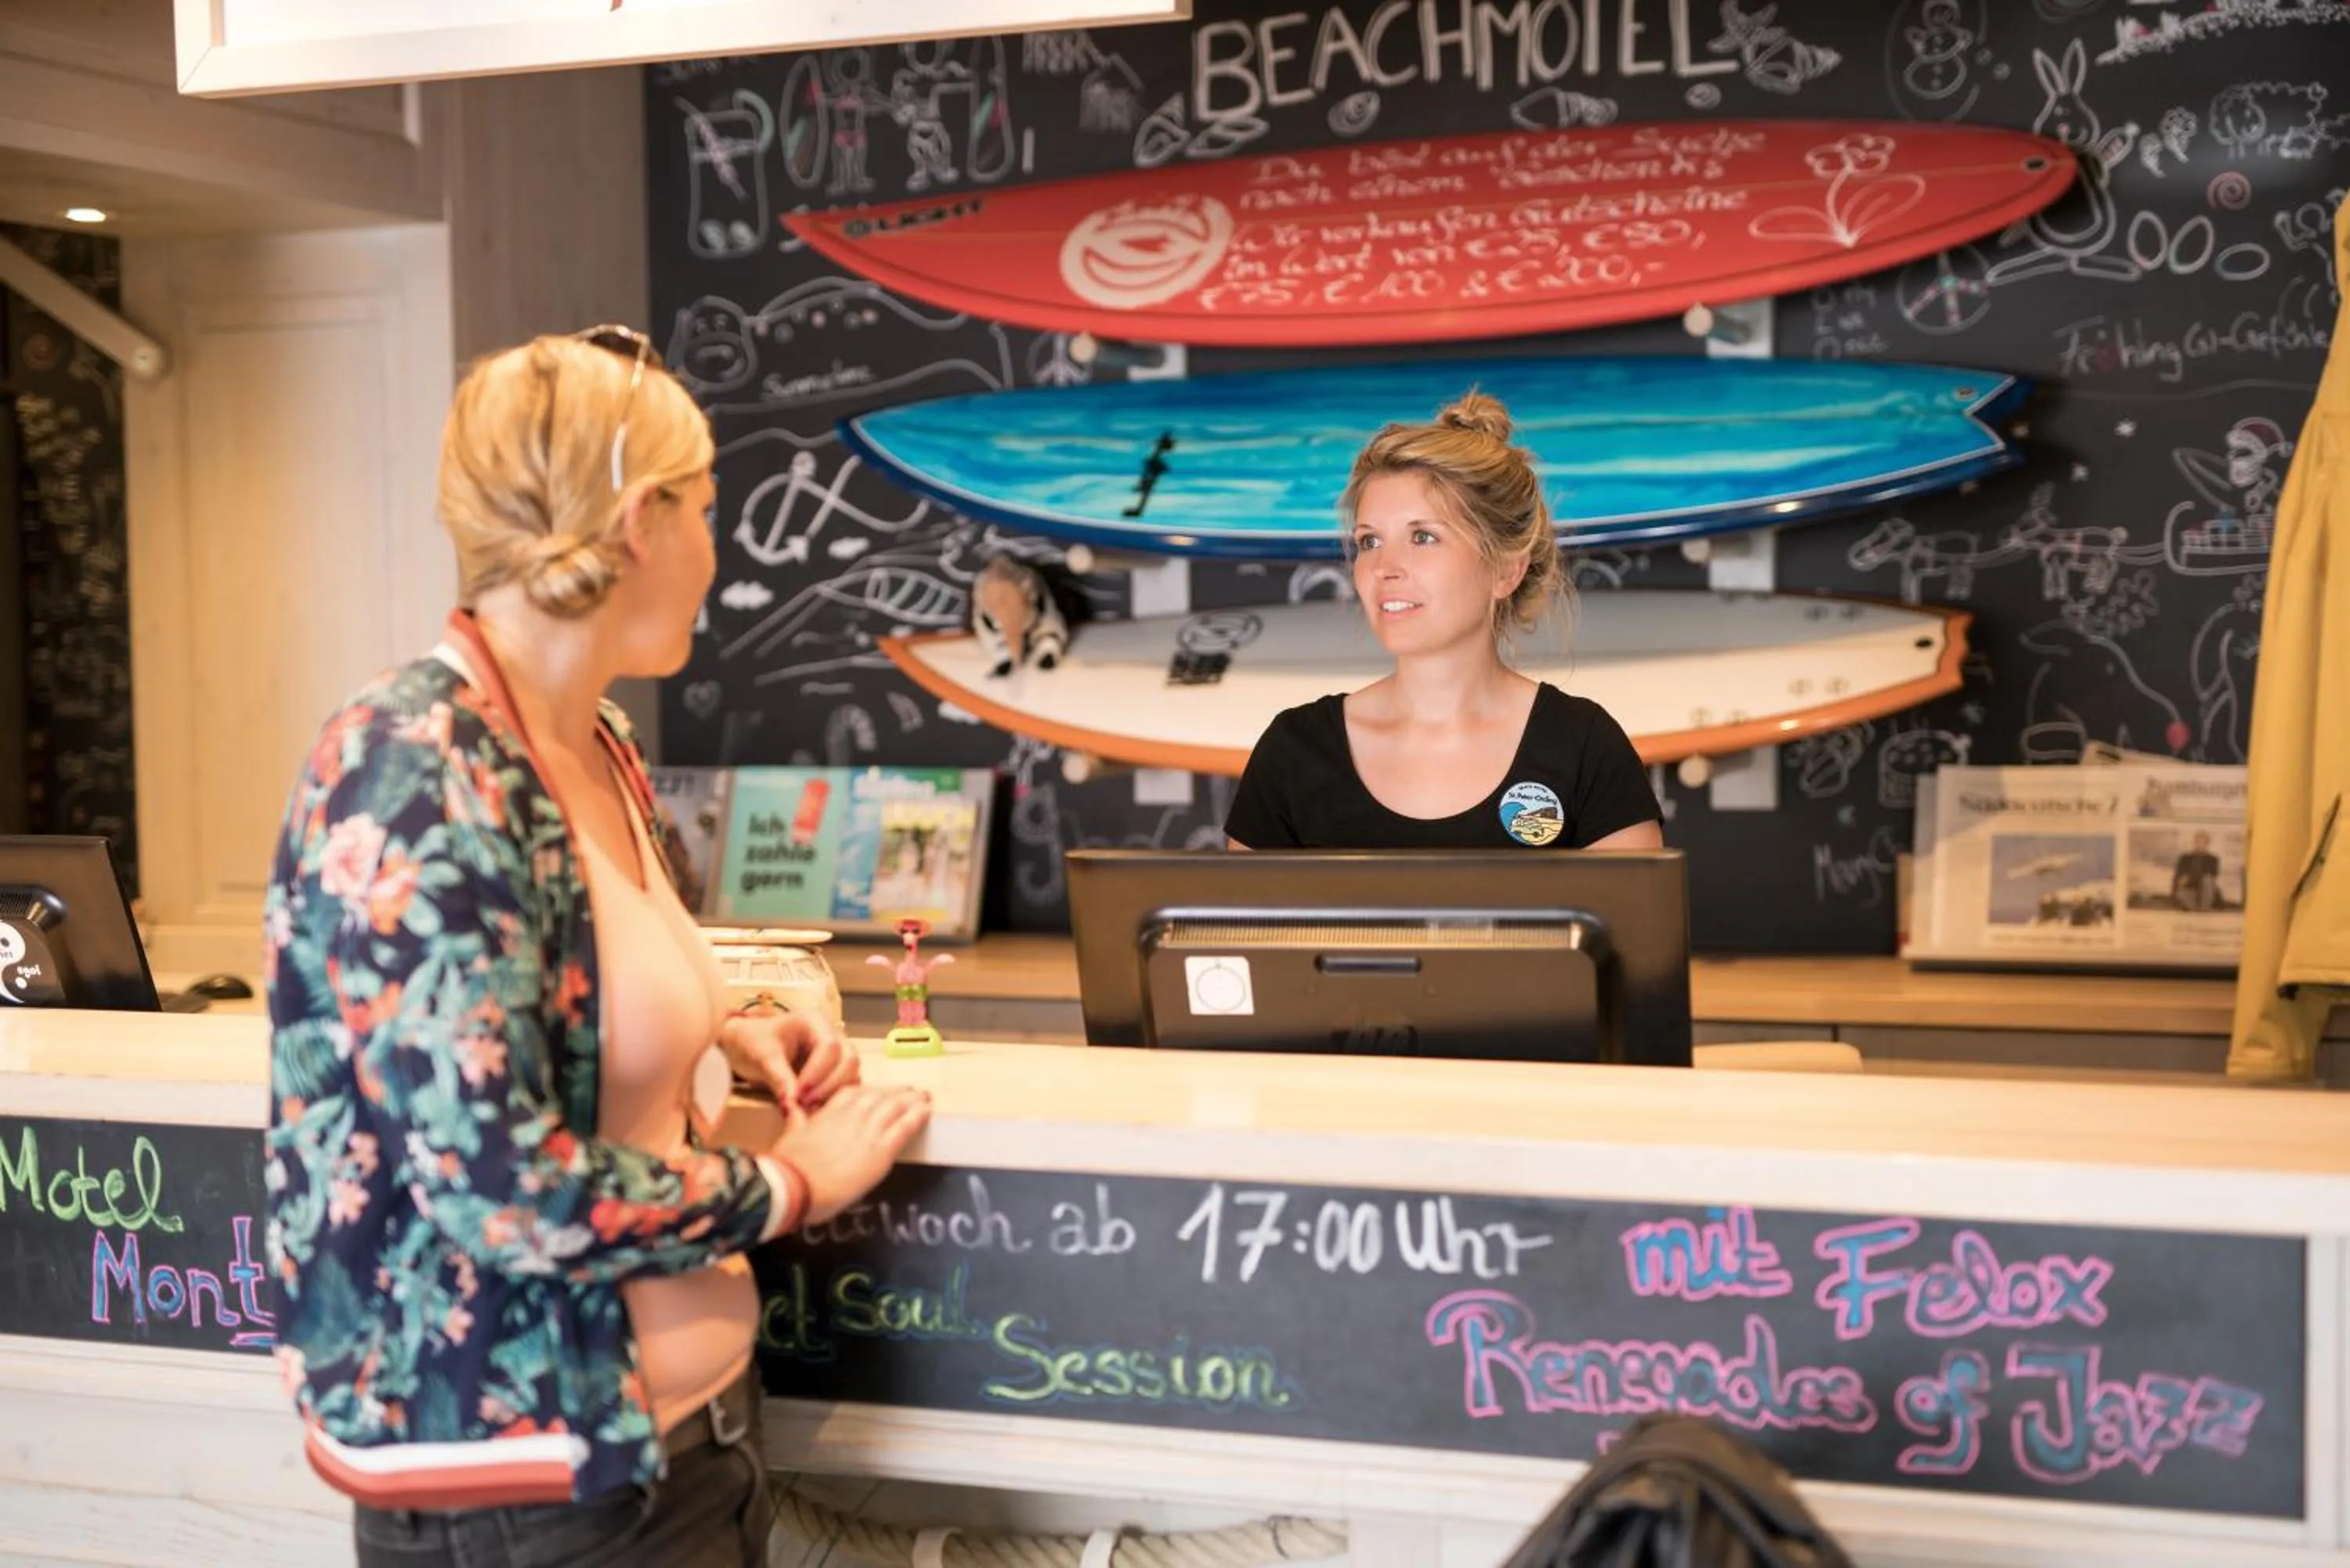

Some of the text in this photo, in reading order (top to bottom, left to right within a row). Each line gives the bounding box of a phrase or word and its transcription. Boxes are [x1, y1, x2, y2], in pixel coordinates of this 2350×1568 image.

[1191, 0, 1740, 121] BEACHMOTEL
[1050, 1182, 1137, 1255] ab
[1177, 1181, 1382, 1284] 17:00
[1394, 1195, 1553, 1279] Uhr
[1620, 1207, 1791, 1301] mit
